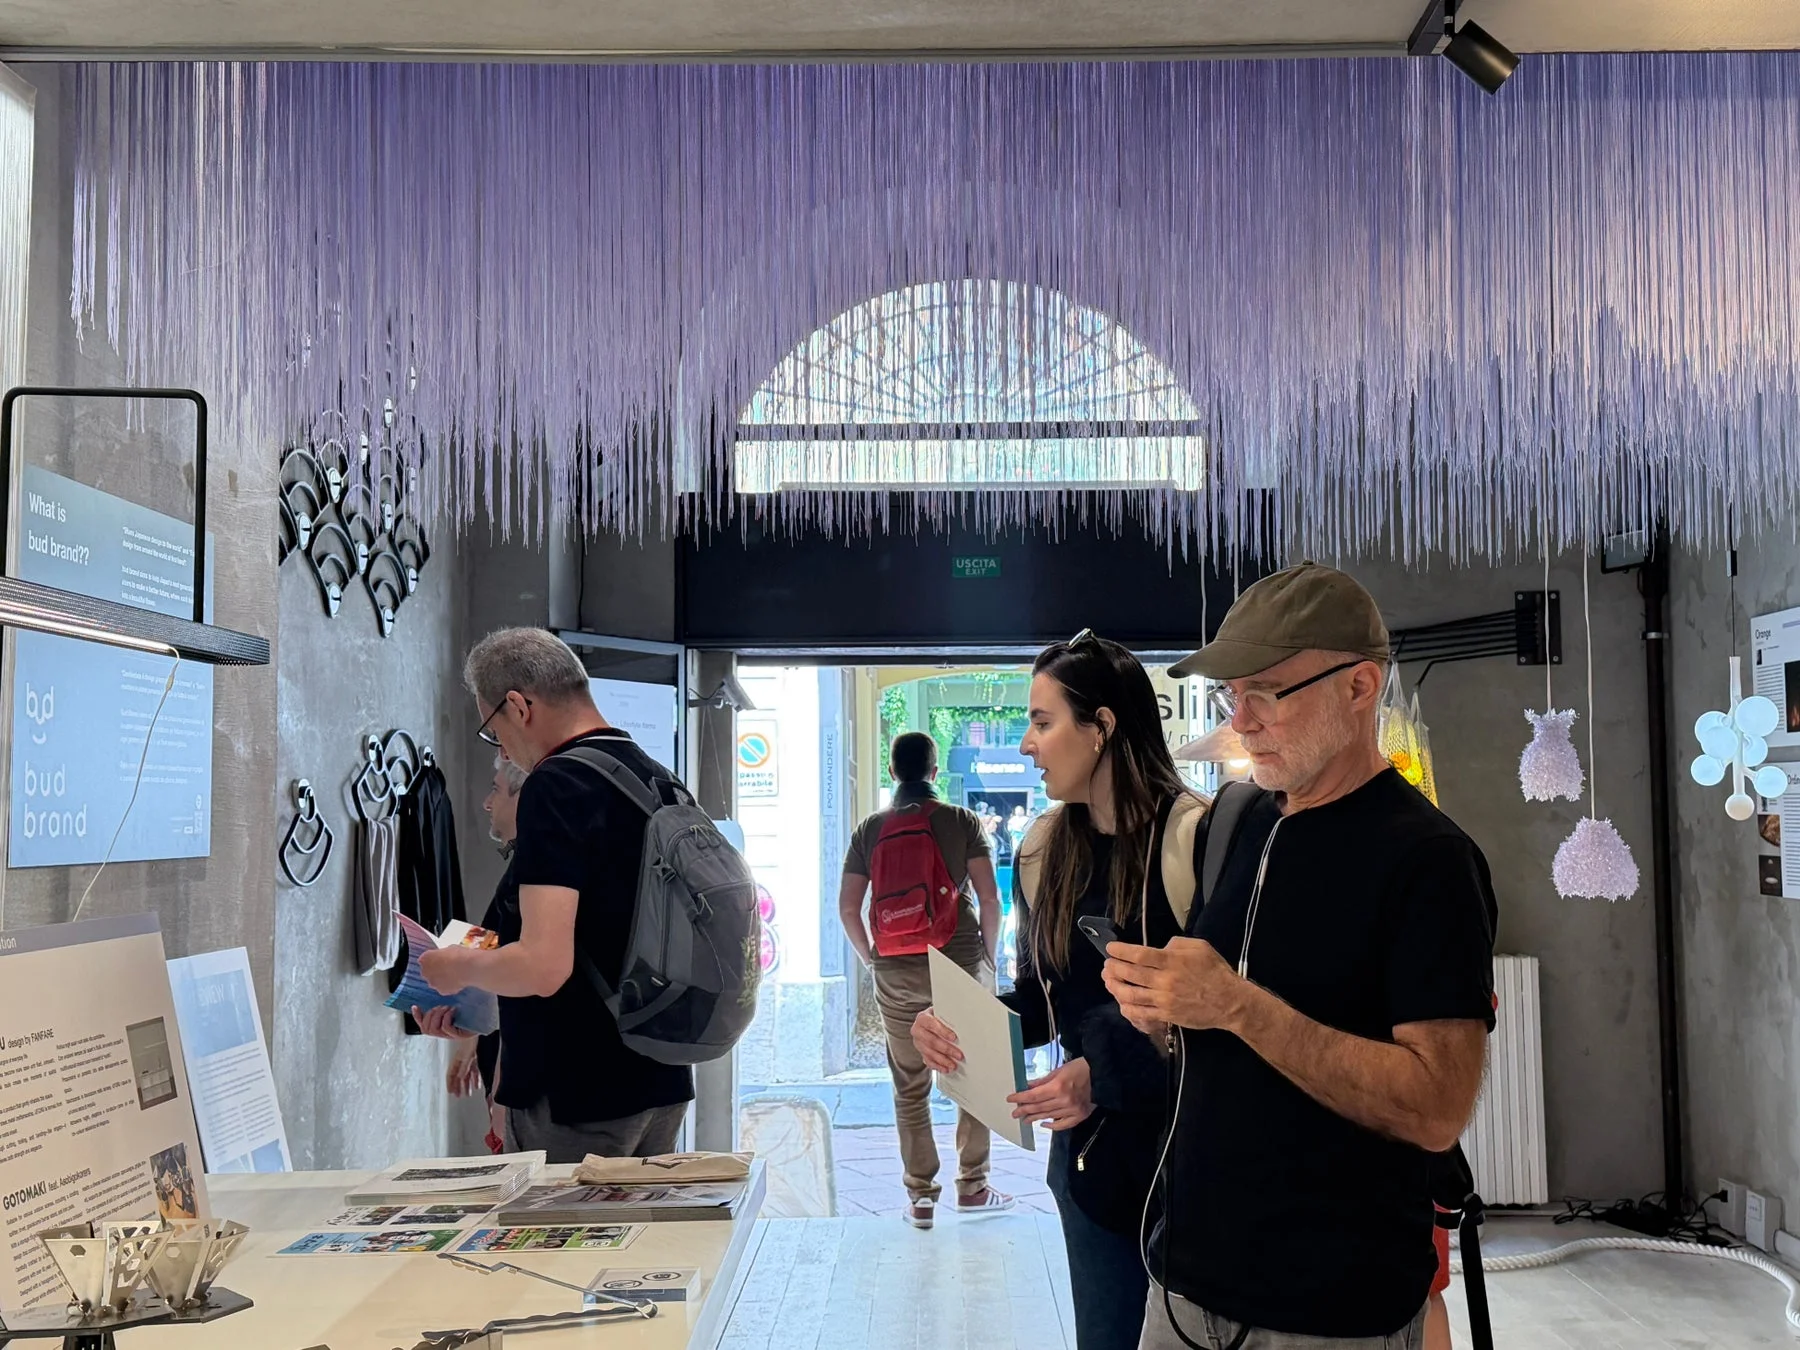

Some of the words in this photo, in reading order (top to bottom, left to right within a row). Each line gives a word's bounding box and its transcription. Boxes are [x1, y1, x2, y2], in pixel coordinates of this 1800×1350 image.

[29, 492, 56, 519] What
[57, 501, 66, 523] is
[28, 530, 48, 554] bud
[51, 537, 90, 565] brand??
[956, 558, 996, 568] USCITA
[965, 567, 986, 576] EXIT
[1755, 629, 1771, 640] Orange
[25, 760, 66, 797] bud
[23, 803, 87, 838] brand
[8, 1037, 24, 1049] design
[24, 1035, 31, 1046] by
[31, 1028, 54, 1042] FANFARE
[3, 1180, 47, 1210] GOTOMAKI
